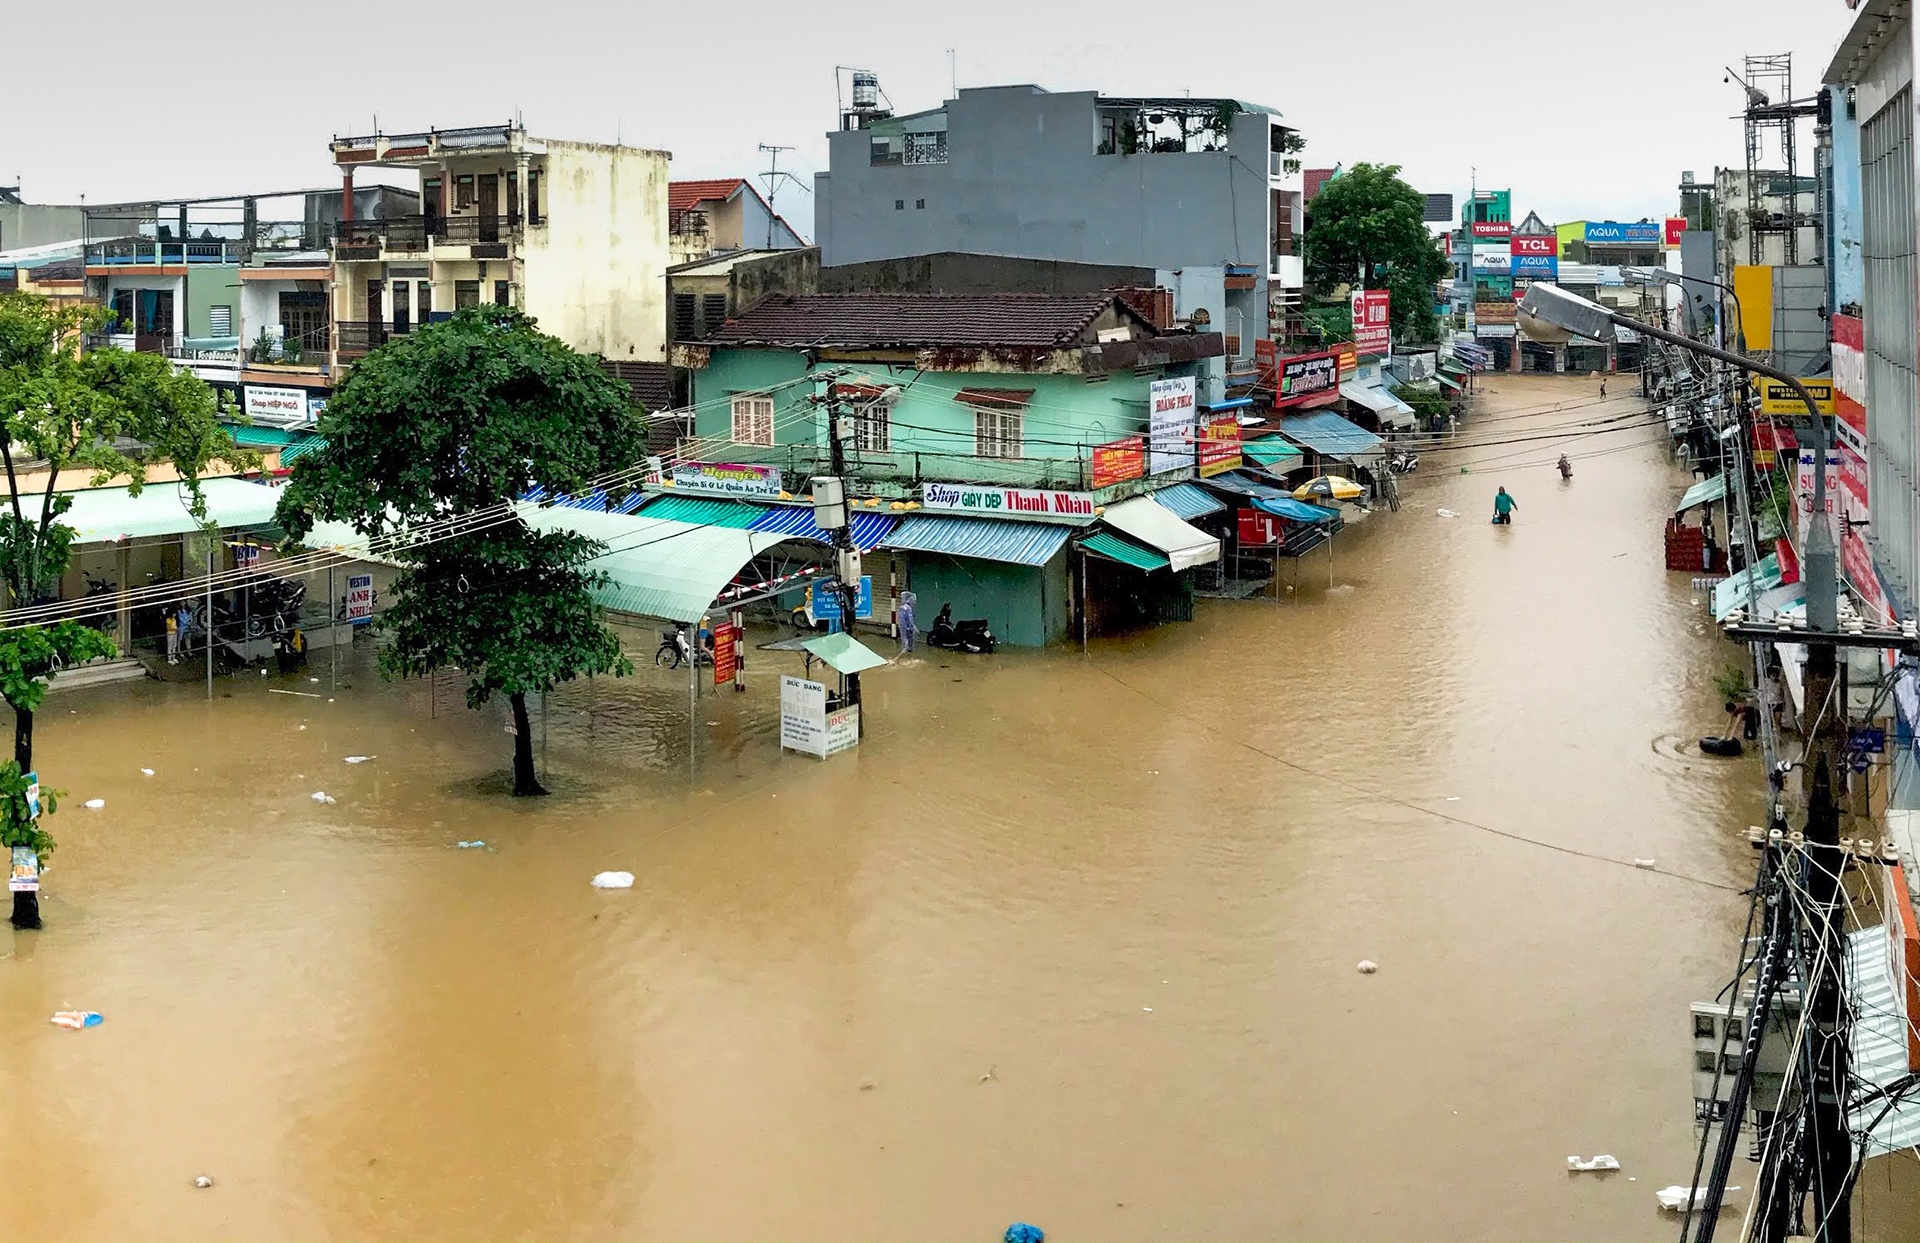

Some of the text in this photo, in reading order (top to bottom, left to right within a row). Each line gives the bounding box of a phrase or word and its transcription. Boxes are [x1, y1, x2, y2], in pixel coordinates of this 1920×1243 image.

[1588, 228, 1619, 237] AQUA
[1519, 240, 1549, 250] TCL
[1520, 257, 1550, 266] AQUA
[676, 479, 699, 488] Chuyên
[769, 486, 781, 494] Em
[926, 485, 960, 507] Shop
[984, 491, 1001, 508] DÉP
[1004, 491, 1049, 512] Thanh
[1054, 494, 1092, 514] Nhàn
[350, 590, 369, 603] ANH
